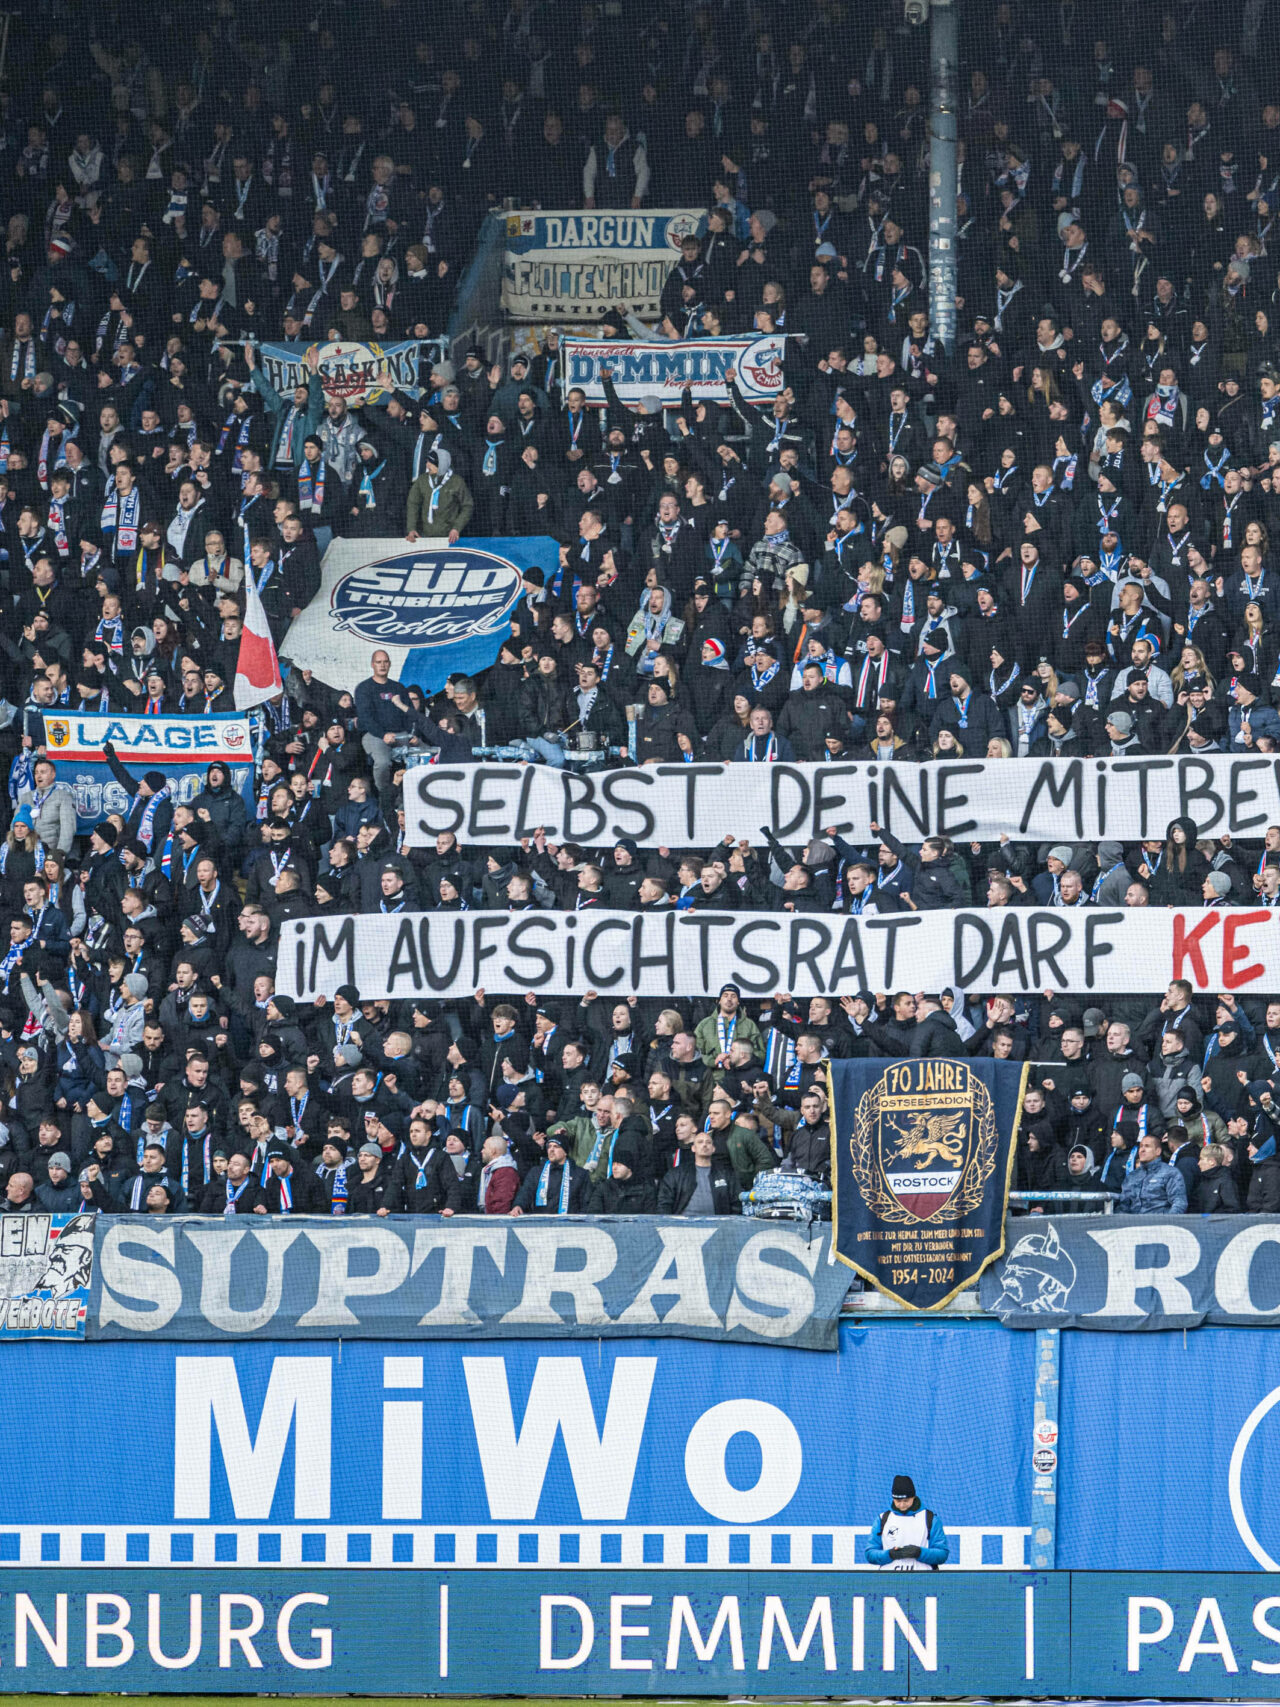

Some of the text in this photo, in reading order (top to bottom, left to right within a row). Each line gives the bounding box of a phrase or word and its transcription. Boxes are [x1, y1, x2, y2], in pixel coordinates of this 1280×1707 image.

[546, 216, 655, 248] DARGUN
[531, 303, 620, 313] SEKTIO
[264, 343, 418, 394] HANSASKINS
[570, 351, 735, 385] DEMMIN
[664, 372, 727, 389] Vorpommer
[348, 562, 517, 593] SÜD
[345, 590, 507, 608] TRIBÜNE
[328, 606, 510, 639] Rostock
[77, 721, 219, 749] LAAGE
[418, 764, 725, 841] SELBST
[953, 911, 1125, 991] DARF
[891, 1062, 964, 1093] 70 JAHRE
[880, 1095, 972, 1108] OSTSEESTADION
[893, 1176, 954, 1188] ROSTOCK
[100, 1226, 823, 1339] SUPTRAS
[892, 1268, 918, 1285] 1954
[929, 1267, 955, 1284] 2024
[174, 1356, 803, 1523] MiWo
[0, 1593, 334, 1670] NBURG
[538, 1594, 940, 1672] DEMMIN
